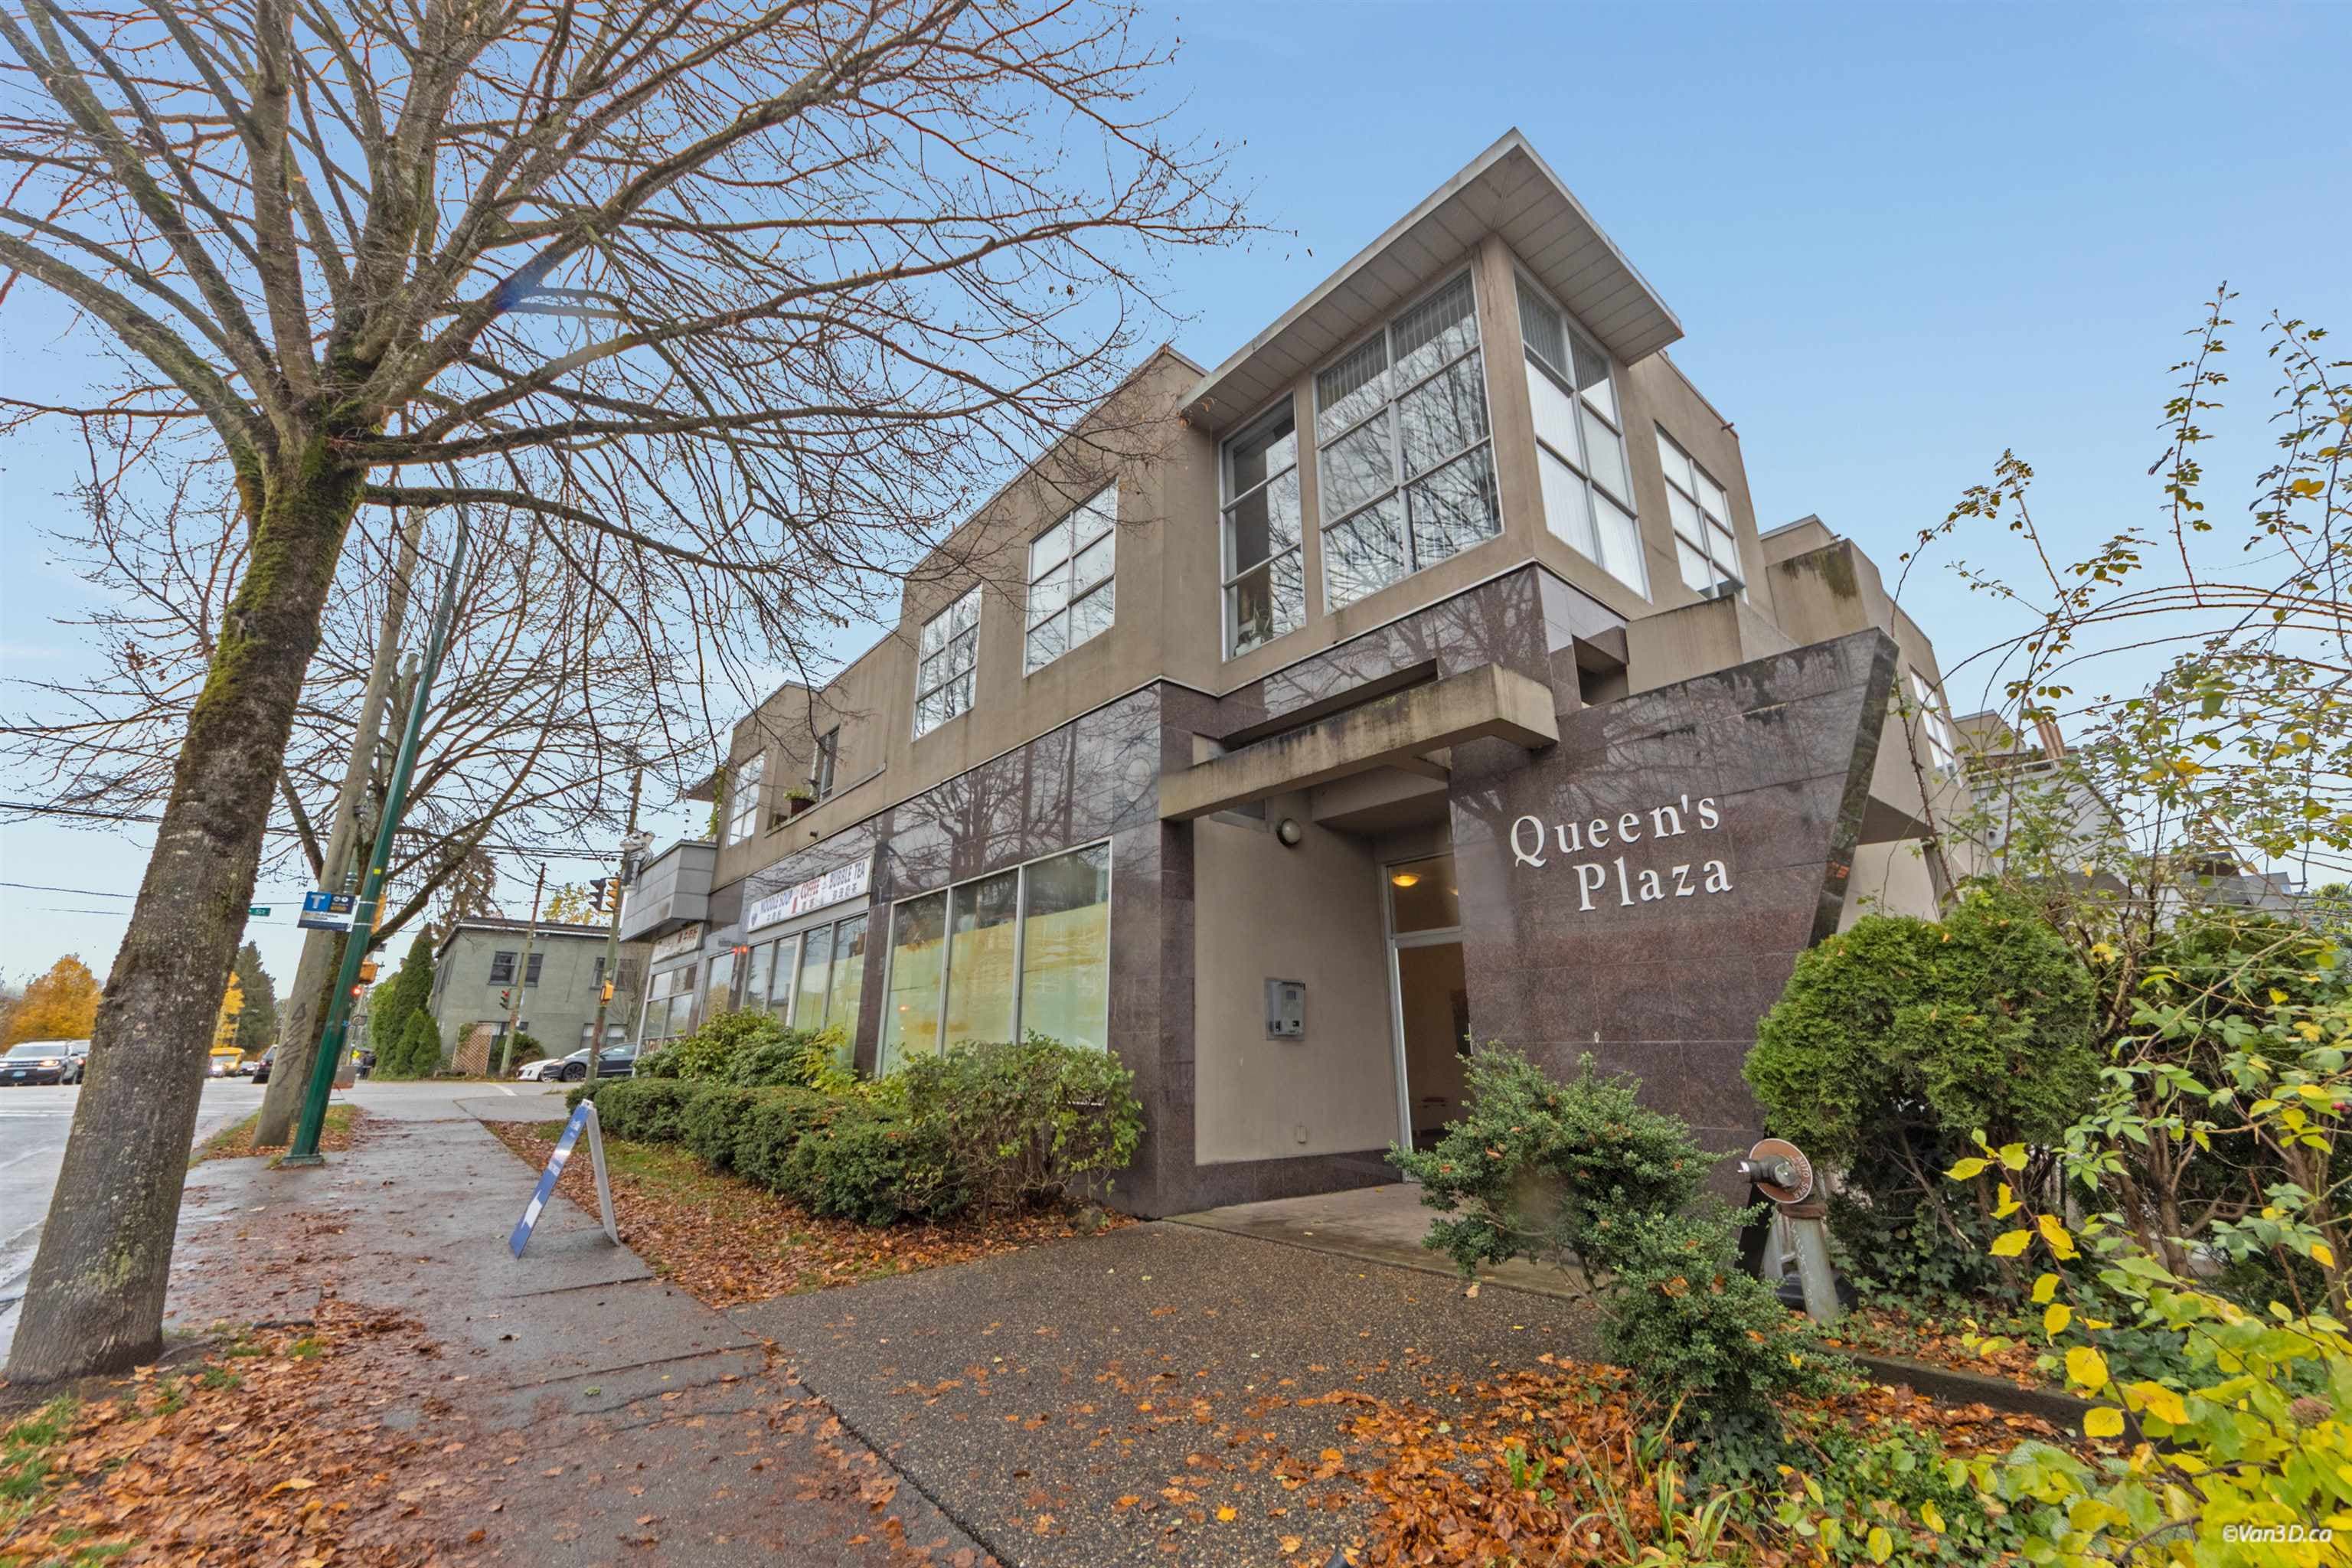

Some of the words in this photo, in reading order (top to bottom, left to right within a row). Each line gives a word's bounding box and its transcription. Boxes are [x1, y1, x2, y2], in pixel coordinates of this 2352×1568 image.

[1511, 794, 1720, 867] Queen's
[801, 879, 820, 899] COFFEE
[829, 865, 851, 889] BUBBLE
[854, 861, 865, 879] TEA
[1573, 856, 1733, 912] Plaza
[1796, 1157, 1810, 1177] AUTO
